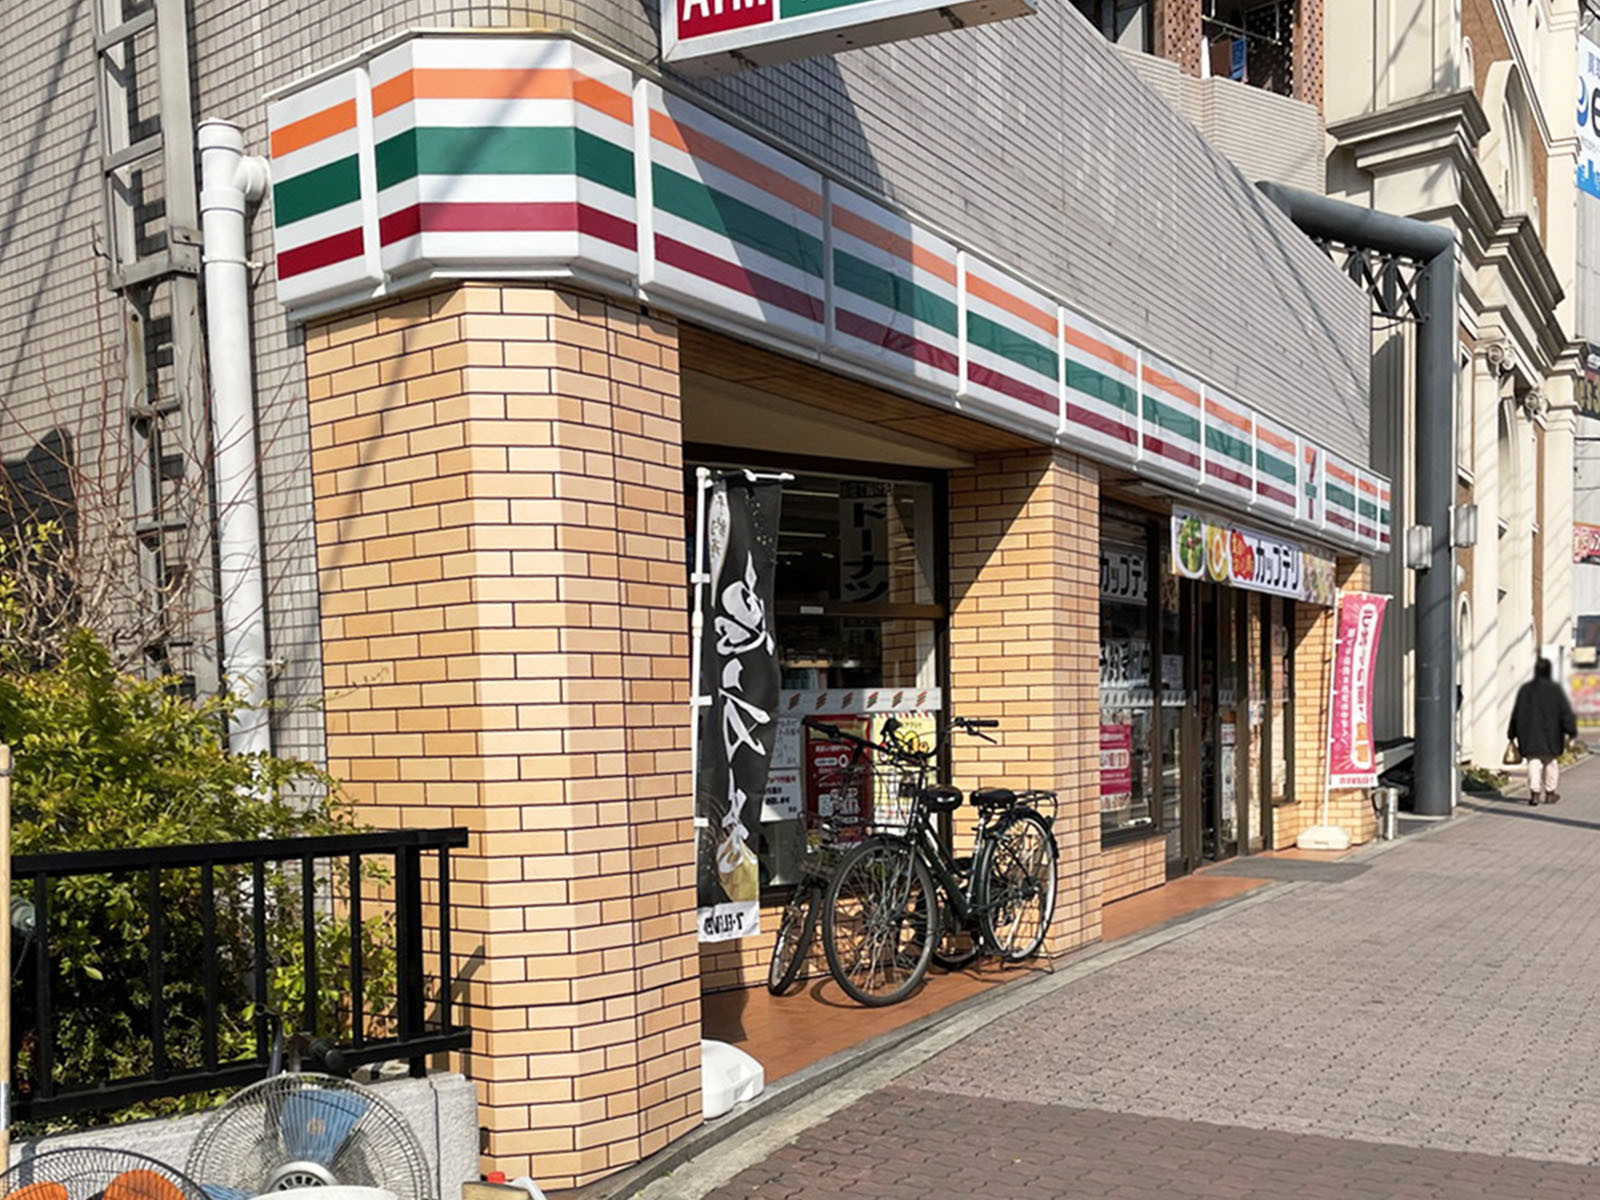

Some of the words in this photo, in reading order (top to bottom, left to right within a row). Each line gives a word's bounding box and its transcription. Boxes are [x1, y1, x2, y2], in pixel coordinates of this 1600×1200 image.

[843, 502, 889, 603] ドーナツ
[1255, 539, 1301, 590] カップデリ
